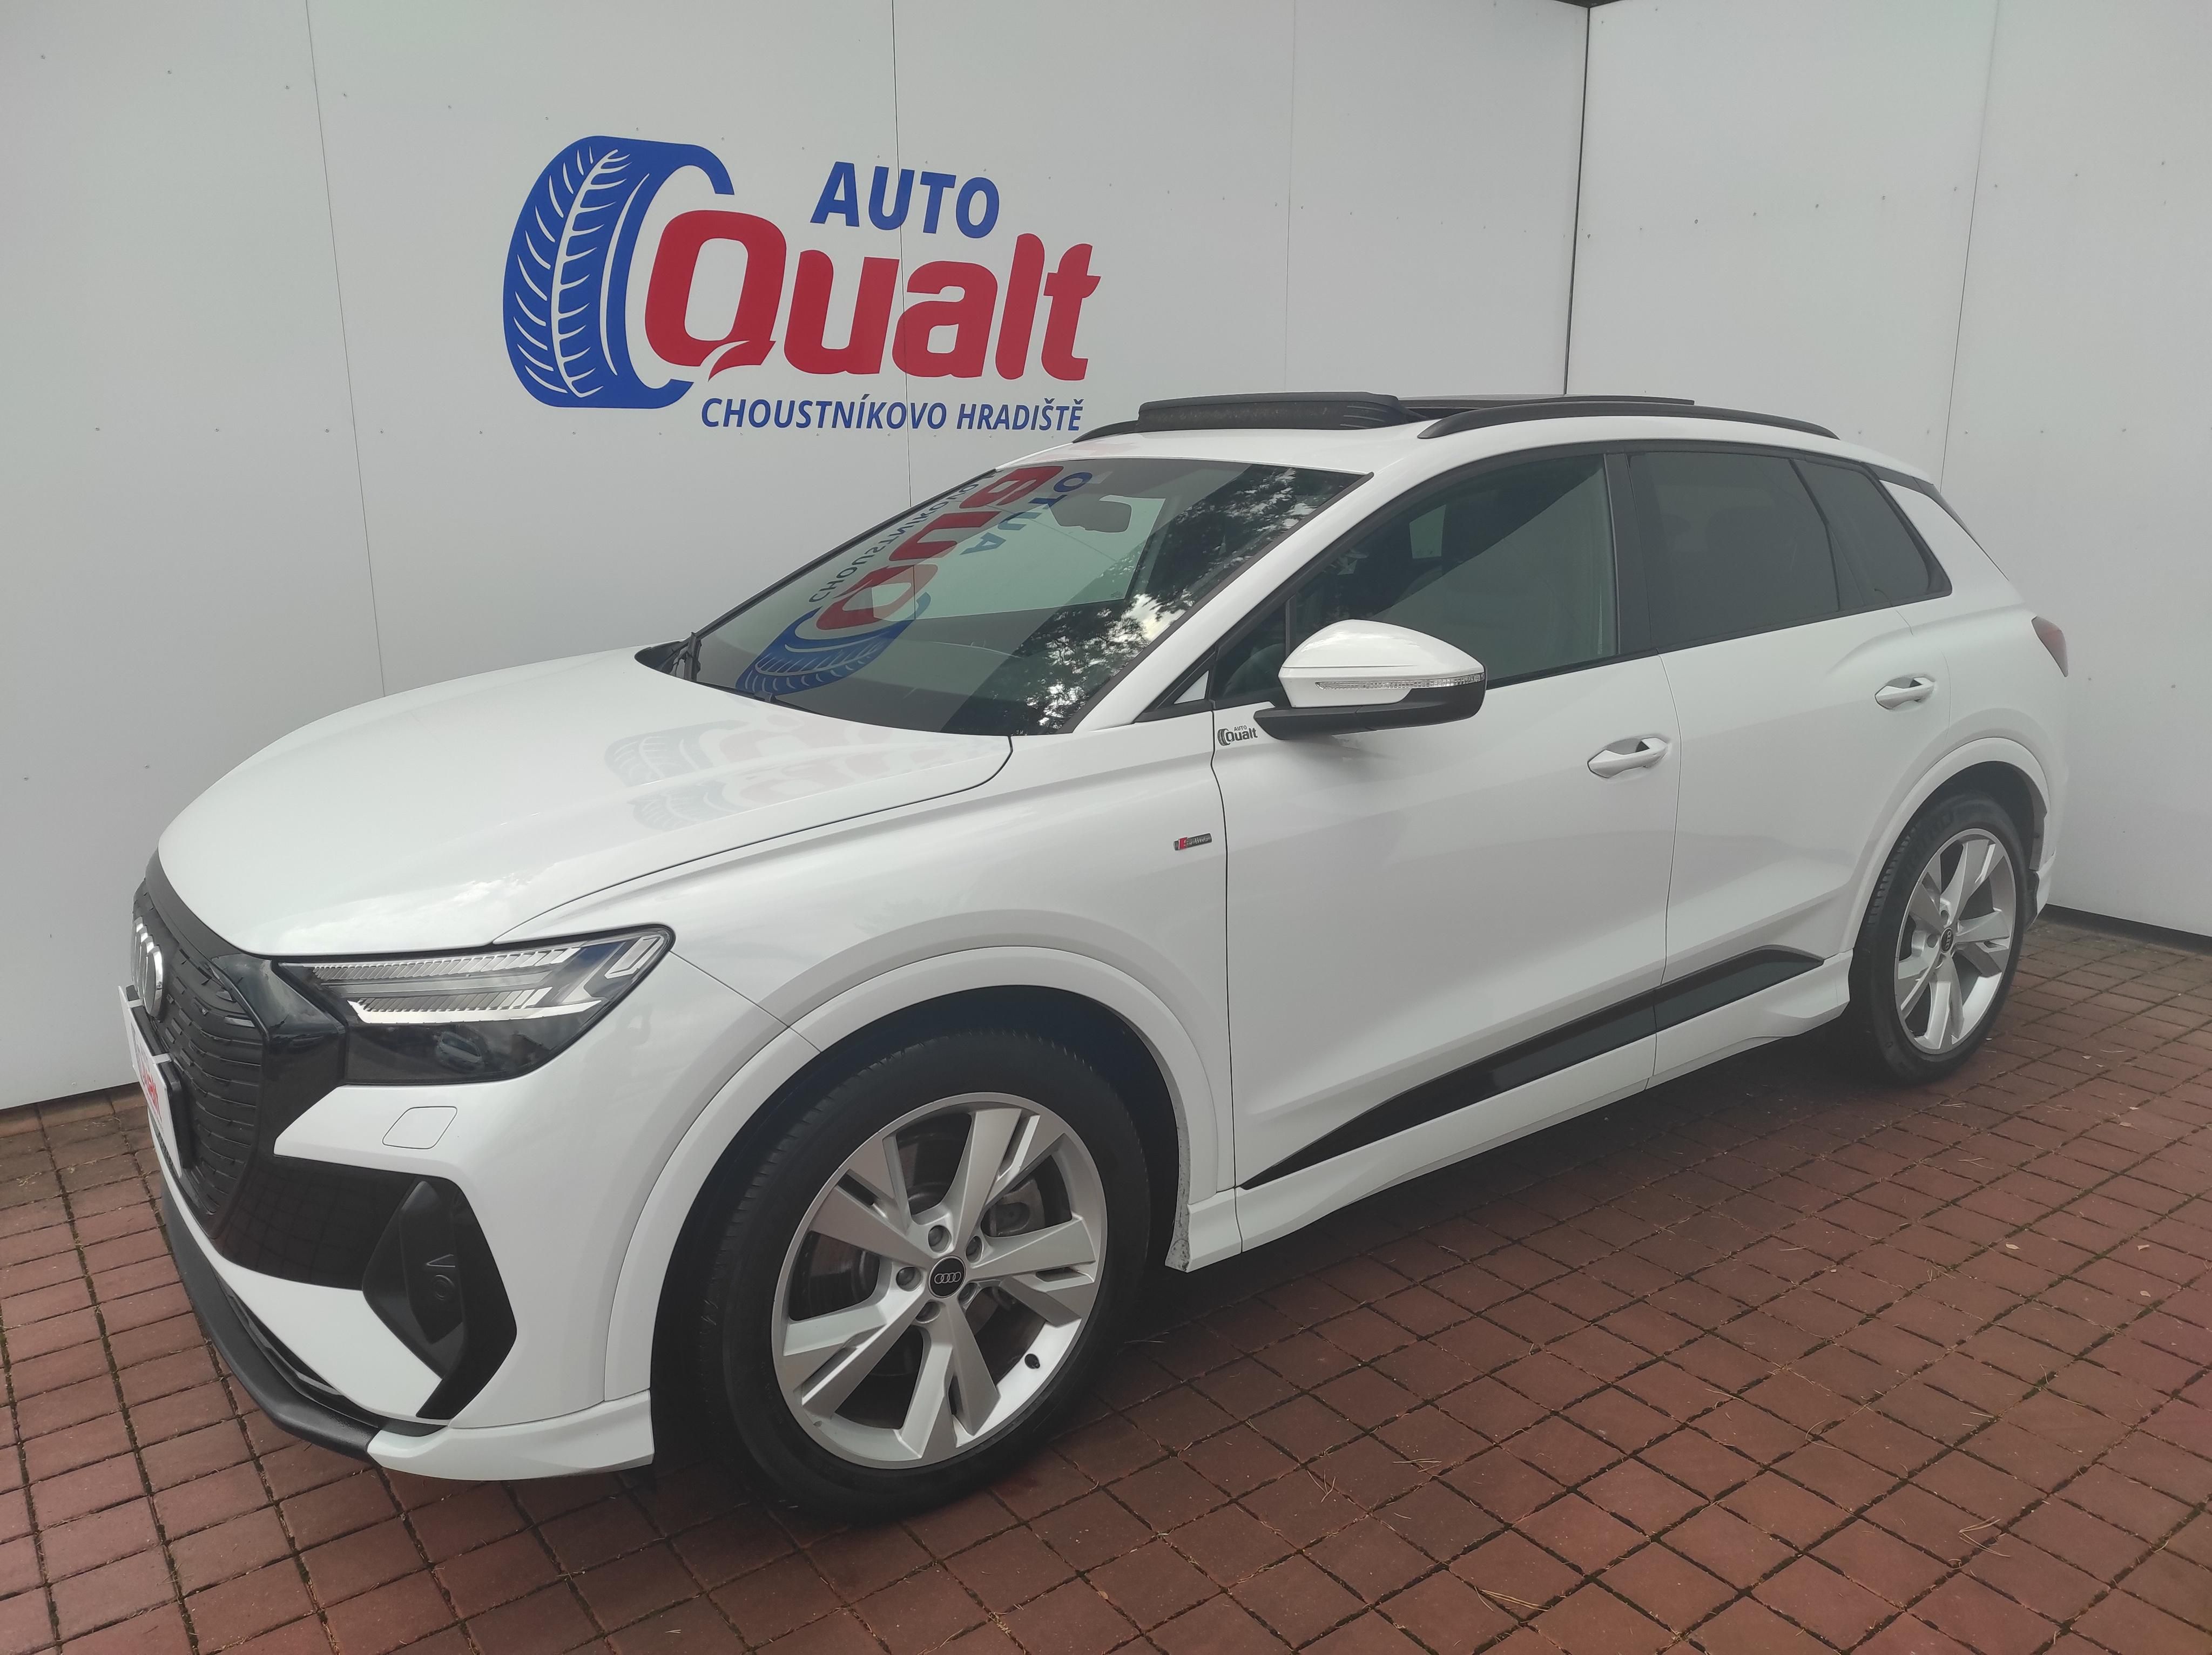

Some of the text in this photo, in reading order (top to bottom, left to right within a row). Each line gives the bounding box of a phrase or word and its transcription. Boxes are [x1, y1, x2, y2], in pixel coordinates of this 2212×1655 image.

[811, 161, 1000, 238] AUTO
[645, 210, 1101, 381] Qualt
[701, 393, 1084, 431] CHOUSTNÍKOVO HRADIŠTĚ
[1225, 727, 1258, 742] Qualt
